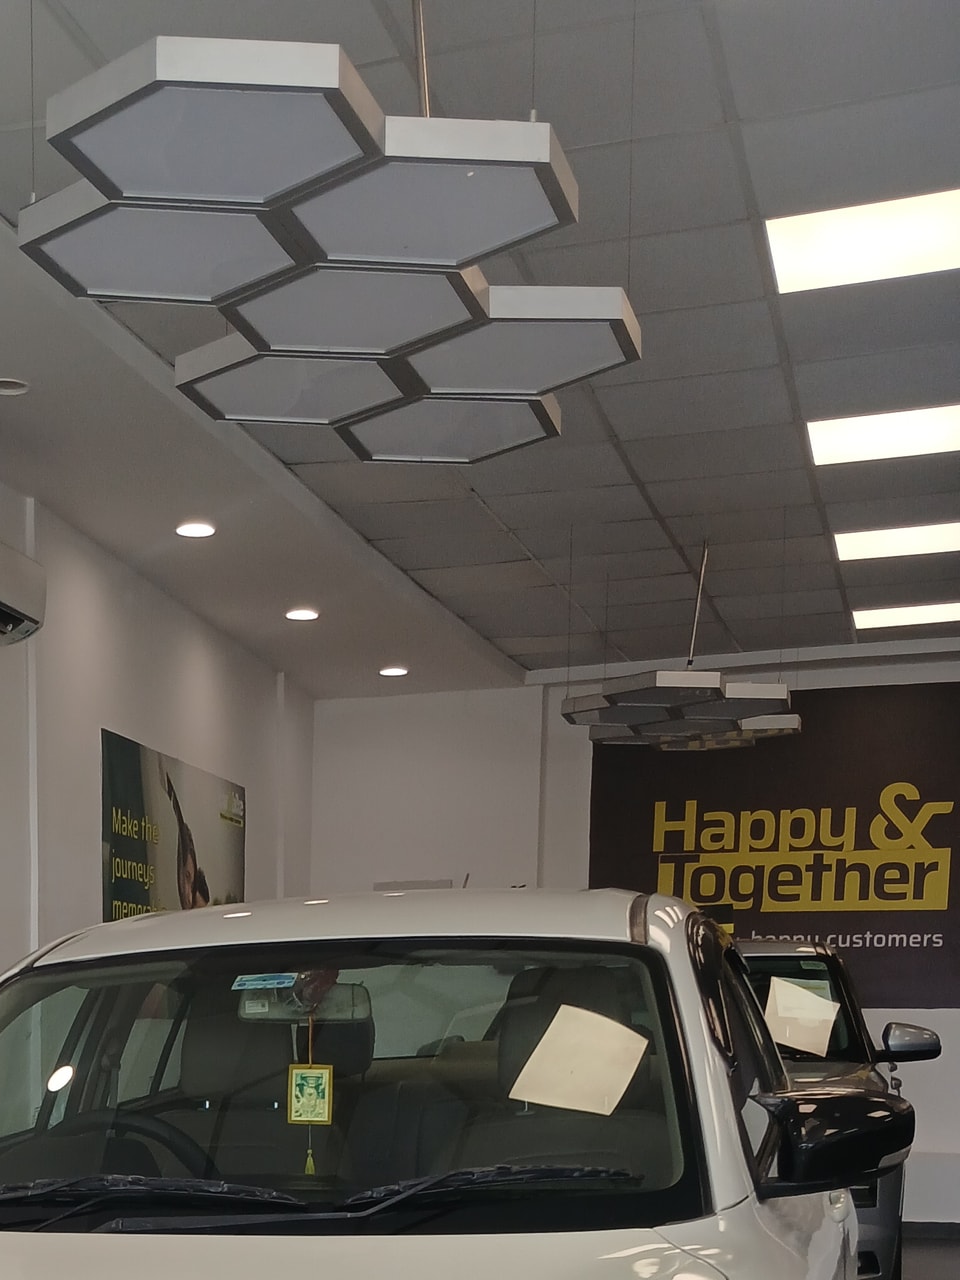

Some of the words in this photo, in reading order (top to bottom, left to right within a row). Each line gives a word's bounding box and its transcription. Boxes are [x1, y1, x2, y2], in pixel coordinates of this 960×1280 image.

[112, 806, 139, 839] Make
[141, 815, 160, 844] the
[652, 800, 857, 852] Happy
[869, 782, 954, 850] &
[111, 848, 155, 889] journeys
[659, 852, 940, 911] Together
[827, 931, 944, 948] customers
